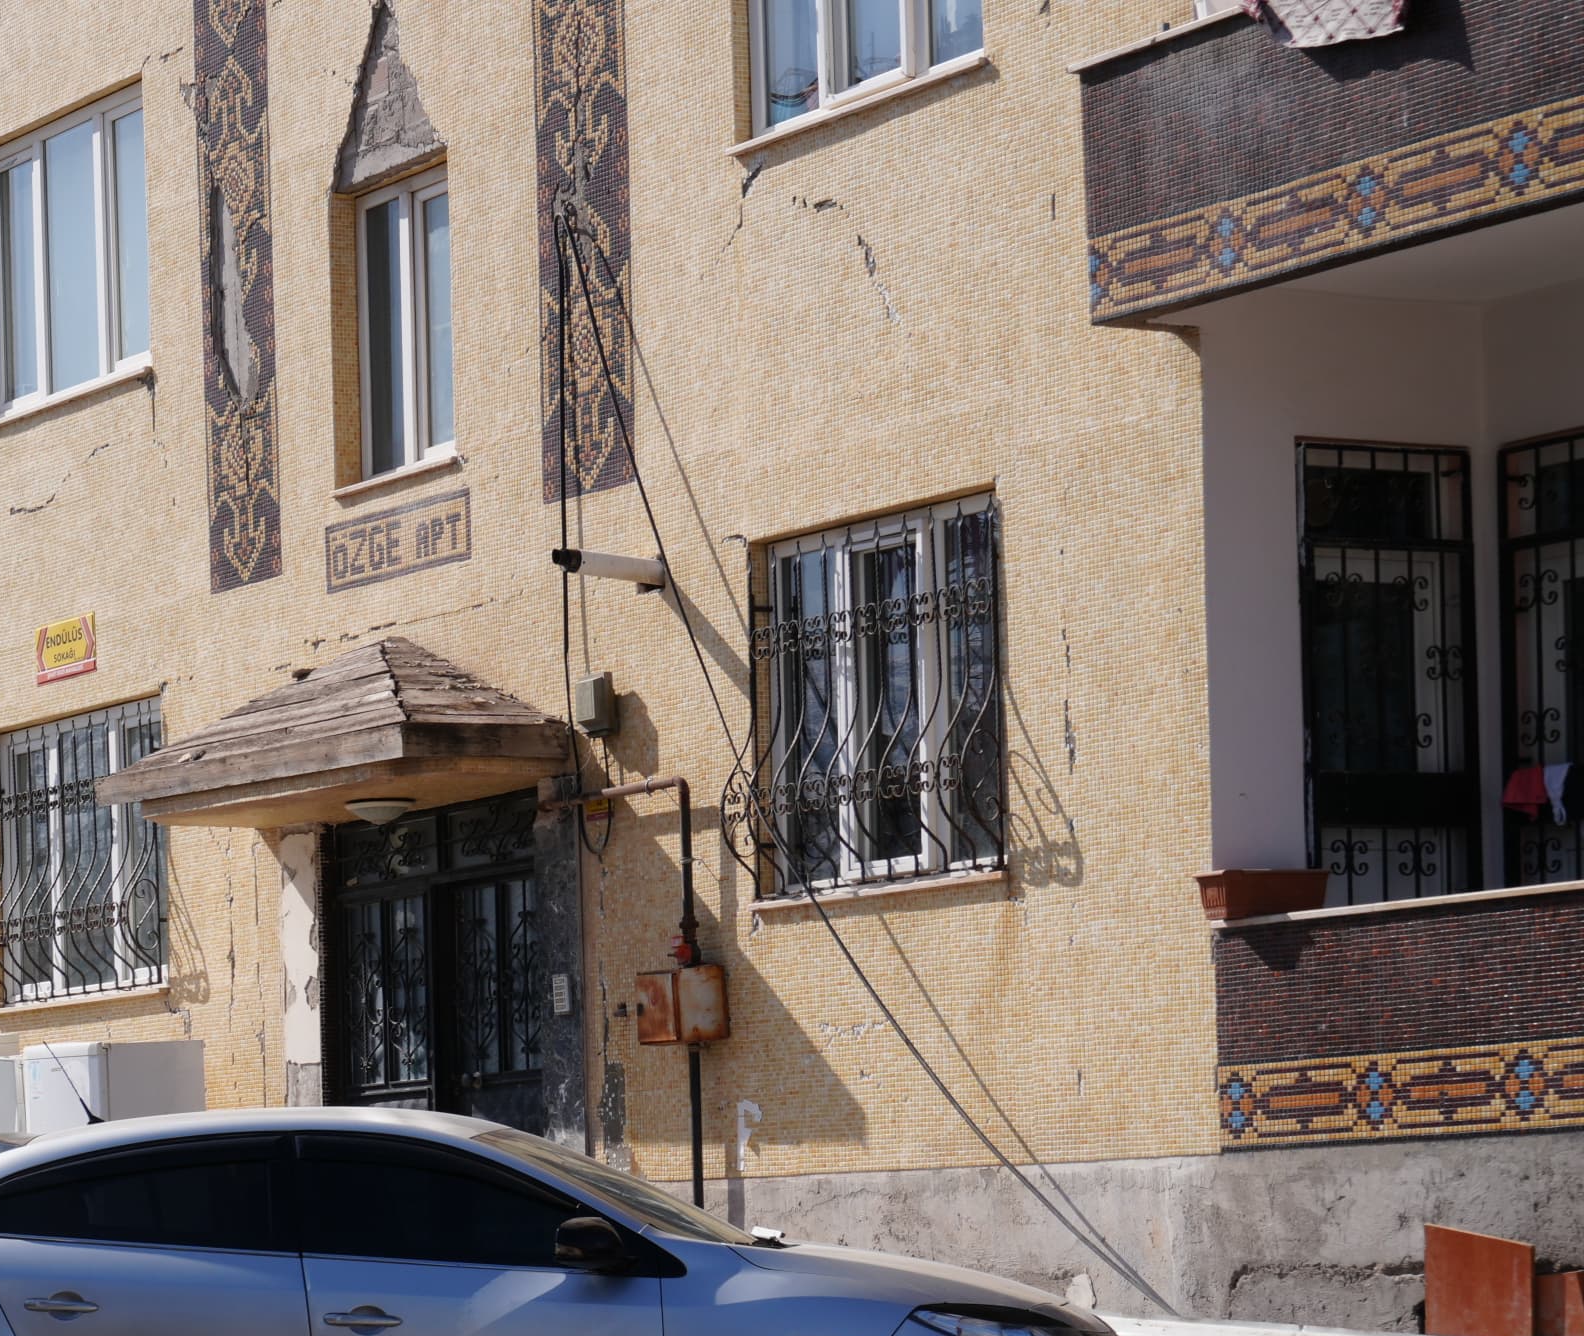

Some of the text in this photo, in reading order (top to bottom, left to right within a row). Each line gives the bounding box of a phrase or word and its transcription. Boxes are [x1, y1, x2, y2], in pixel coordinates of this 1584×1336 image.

[332, 512, 462, 580] ÖZGE APT
[45, 625, 84, 649] ENDÜLÜS
[53, 647, 76, 663] SOKAĞI
